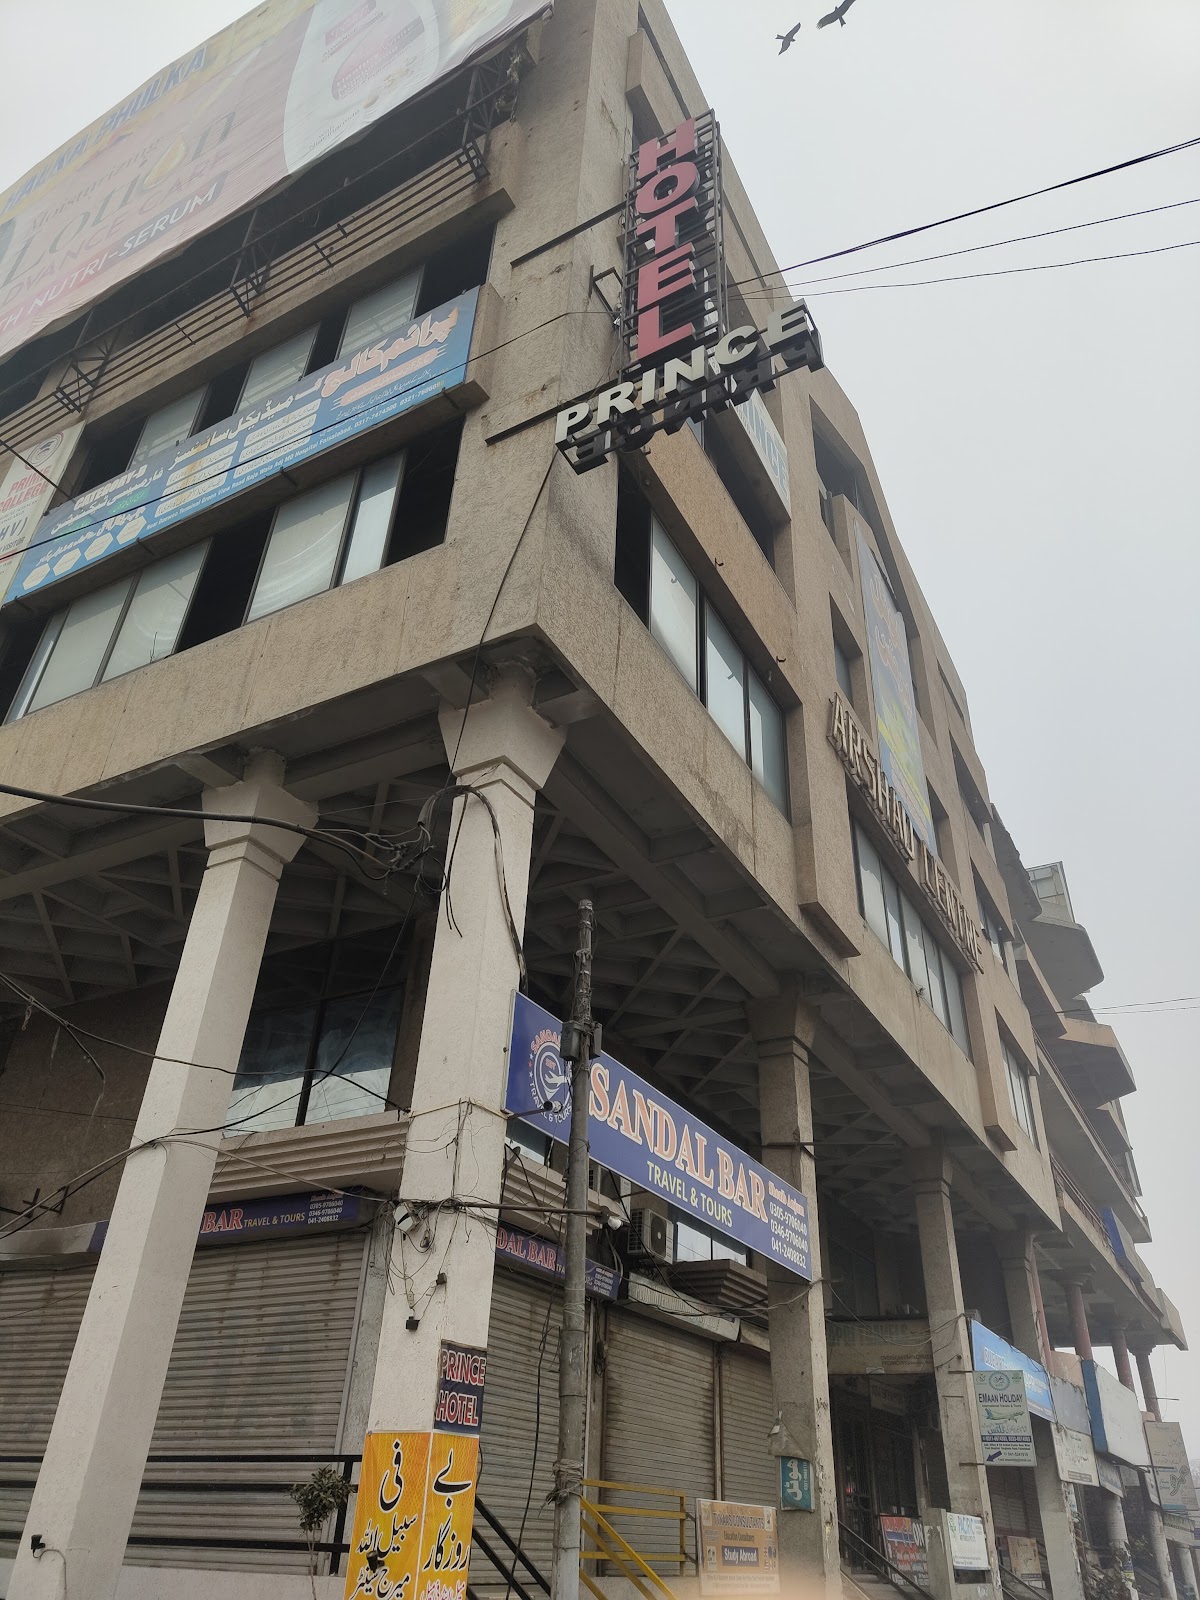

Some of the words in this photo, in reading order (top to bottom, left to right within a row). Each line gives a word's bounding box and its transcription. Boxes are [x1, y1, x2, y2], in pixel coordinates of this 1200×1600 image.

[92, 46, 207, 146] PHULKA
[27, 181, 219, 317] NUTRI-SERUM
[635, 117, 698, 360] HOTEL
[555, 298, 810, 446] PRINCE
[7, 465, 53, 498] PRIME
[589, 1063, 715, 1190] SANDAL
[717, 1147, 769, 1224] BAR
[200, 1208, 243, 1234] BAR
[244, 1216, 271, 1228] TRAVEL
[272, 1215, 278, 1225] &
[280, 1212, 306, 1224] TOURS
[647, 1160, 688, 1203] TRAVEL
[690, 1187, 699, 1208] &
[700, 1193, 733, 1228] TOURS
[527, 1239, 558, 1272] BAR
[441, 1349, 487, 1387] PRINCE
[978, 1392, 999, 1404] EMAAN
[999, 1392, 1023, 1404] HOLIDAY
[435, 1390, 479, 1427] HOTEL
[379, 1439, 404, 1512] فی
[432, 1448, 473, 1508] بے
[422, 1512, 471, 1573] روزگار
[724, 1547, 740, 1564] Study
[740, 1548, 758, 1562] Abroad
